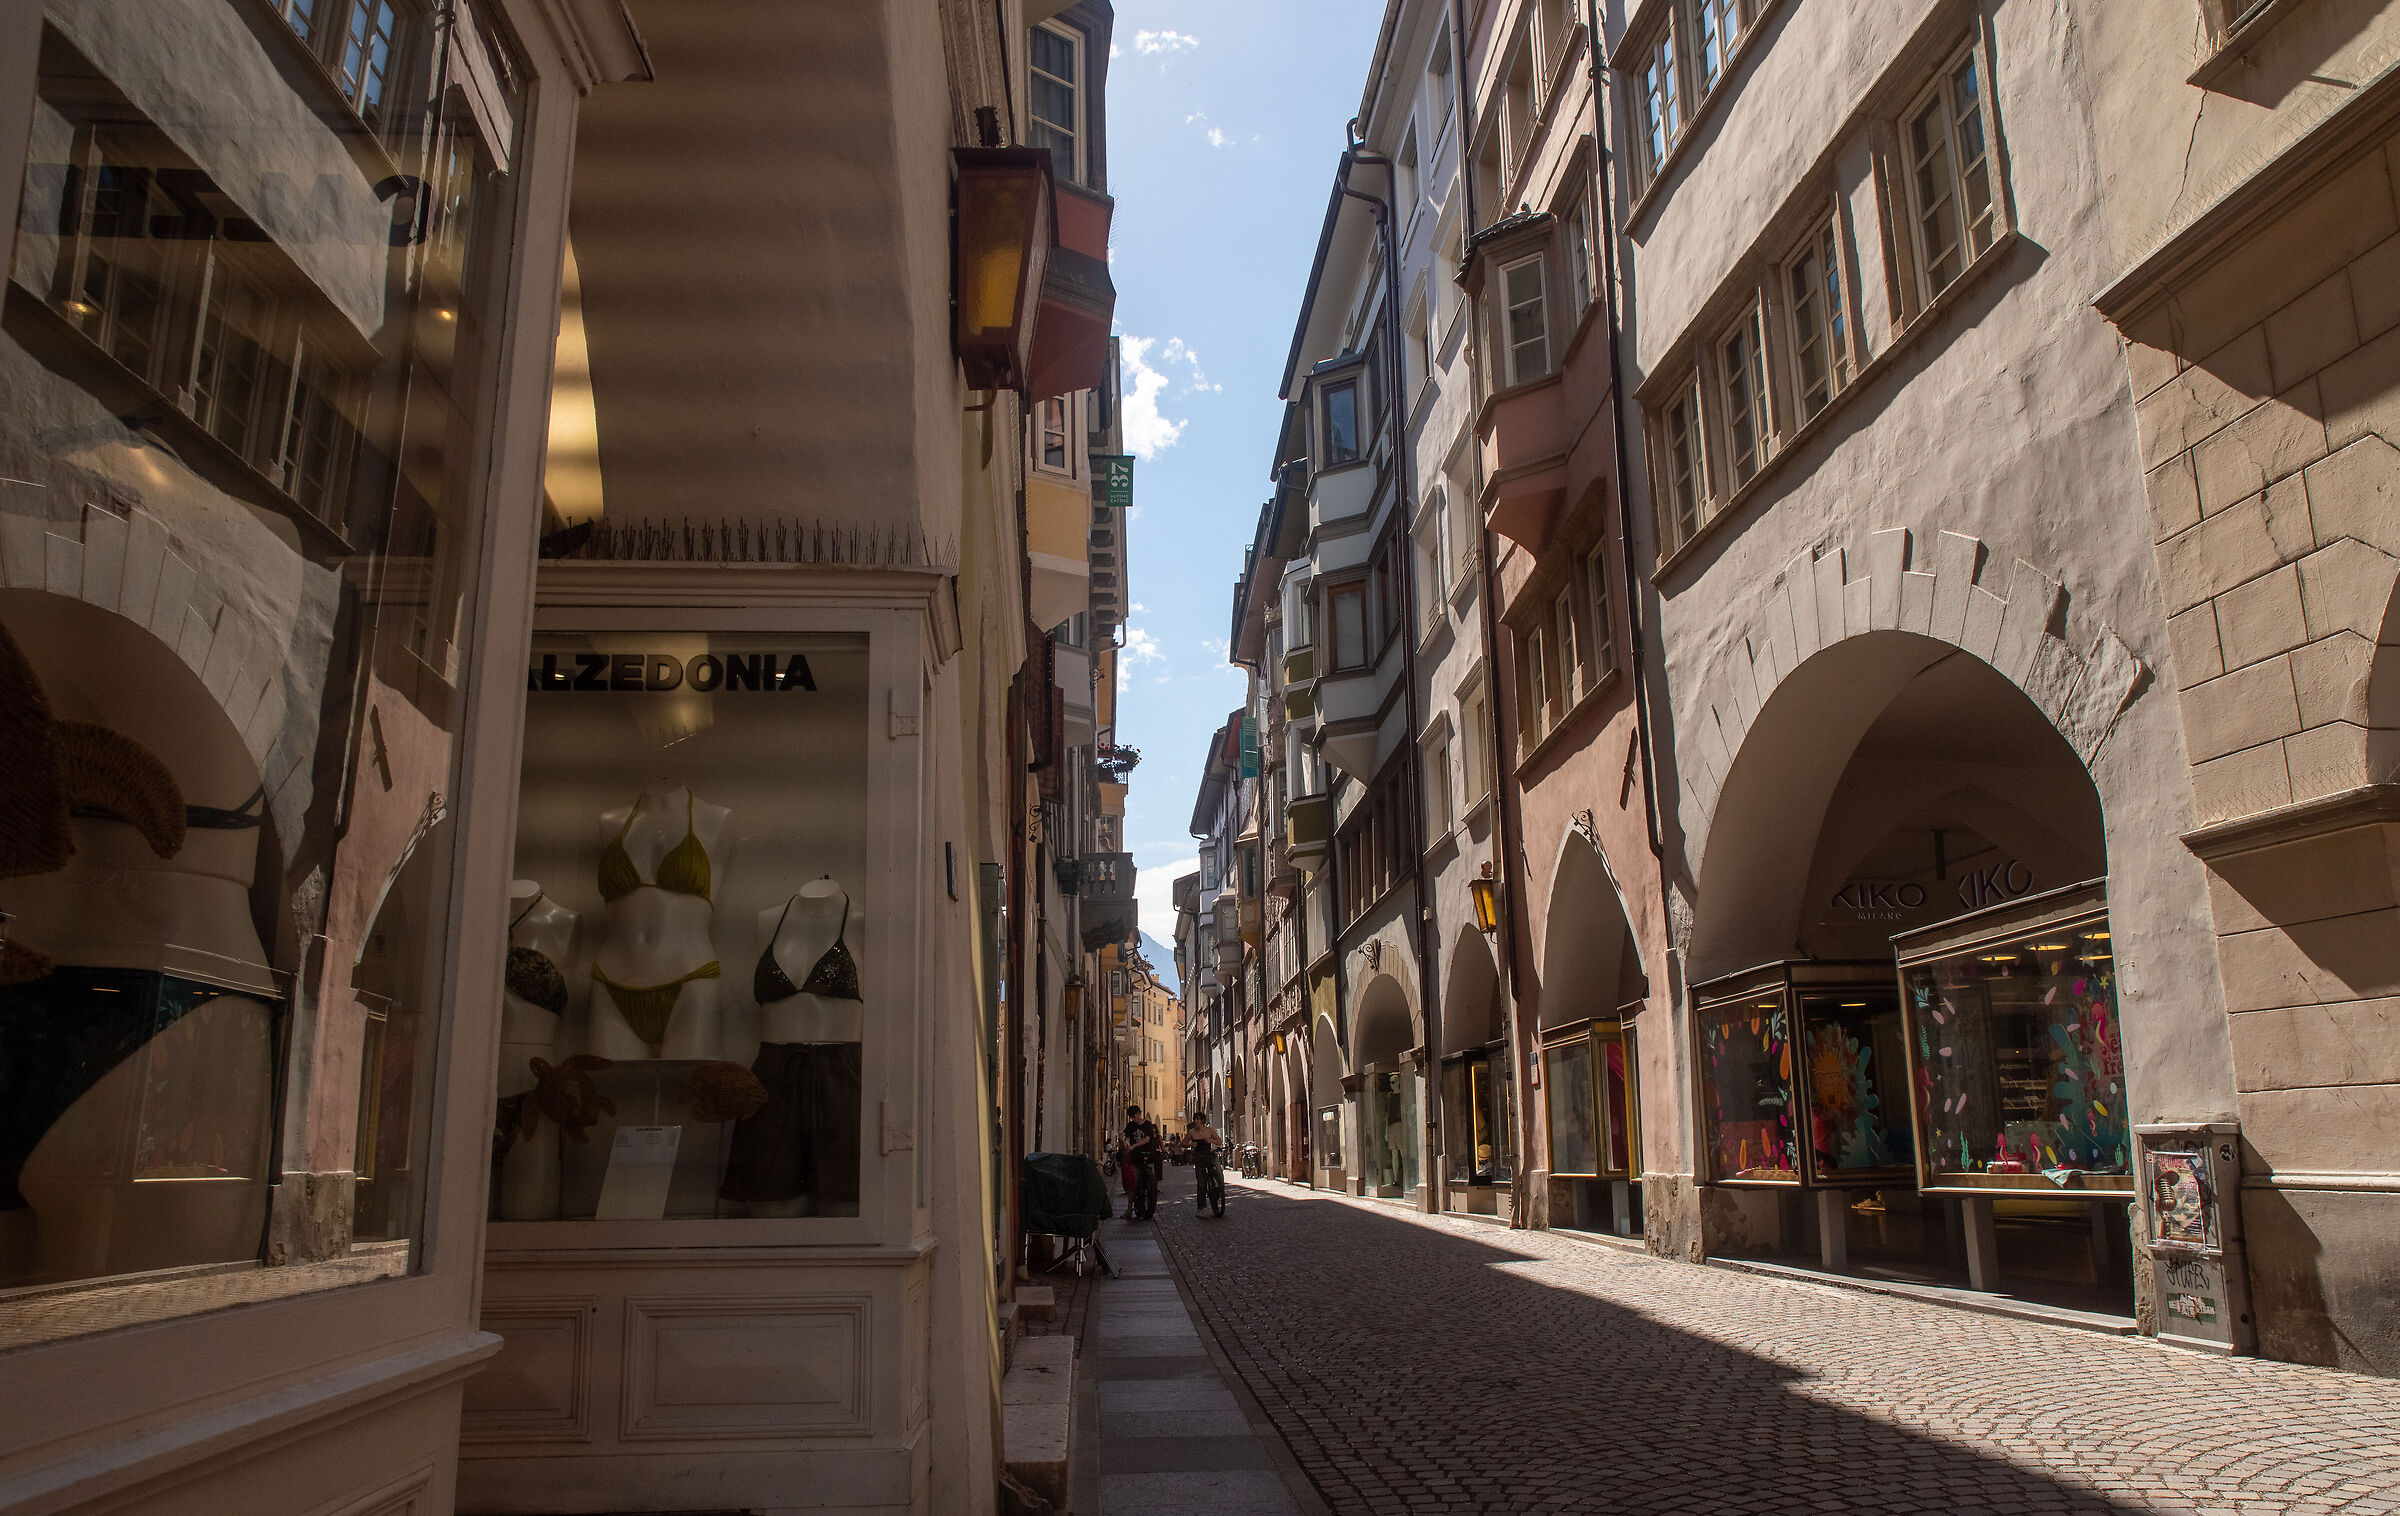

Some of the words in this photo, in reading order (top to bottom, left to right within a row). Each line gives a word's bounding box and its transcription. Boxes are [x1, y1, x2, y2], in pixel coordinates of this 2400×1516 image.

[1111, 462, 1129, 487] 37
[527, 654, 817, 691] LZEDONIA
[1831, 882, 1927, 909] KIKO
[1958, 860, 2032, 910] KIKO
